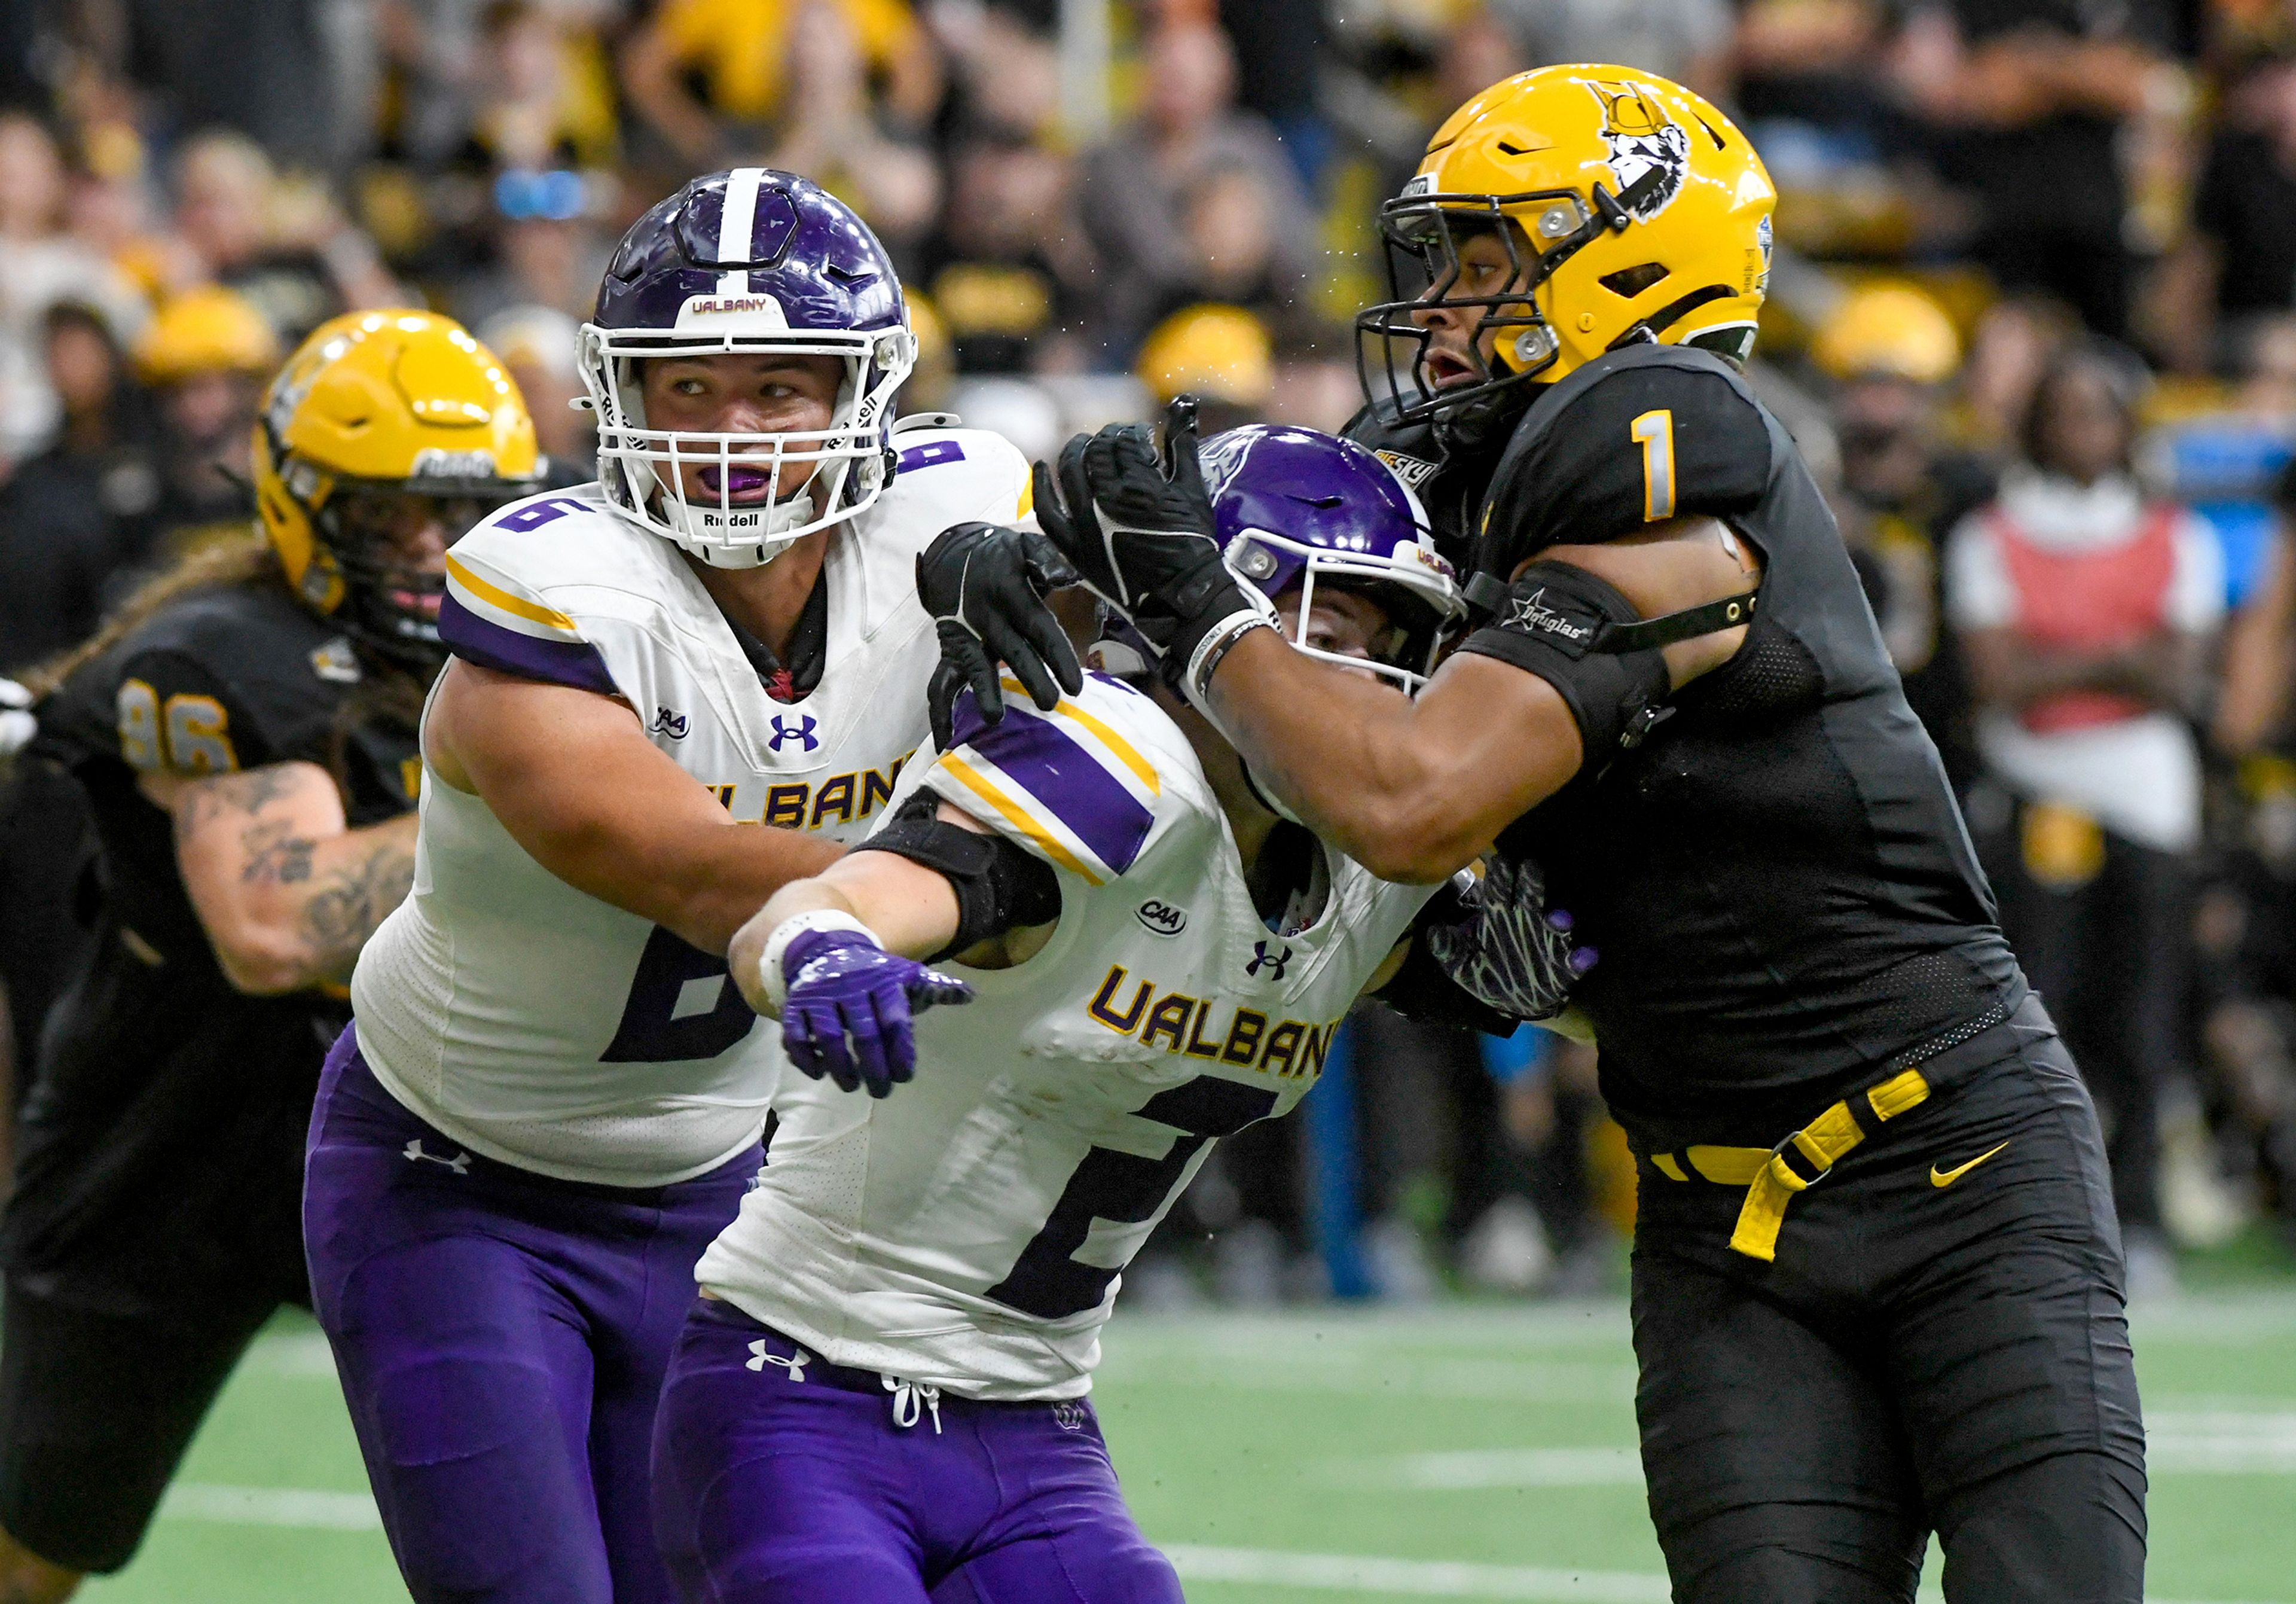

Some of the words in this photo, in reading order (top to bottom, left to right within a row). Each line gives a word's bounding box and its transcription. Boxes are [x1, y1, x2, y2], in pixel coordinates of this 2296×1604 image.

[692, 299, 766, 313] UALBANY
[1631, 410, 1675, 522] 1
[492, 498, 597, 533] 6
[120, 678, 238, 773] 96
[1140, 901, 1181, 929] CAA
[984, 1075, 1280, 1319] 2
